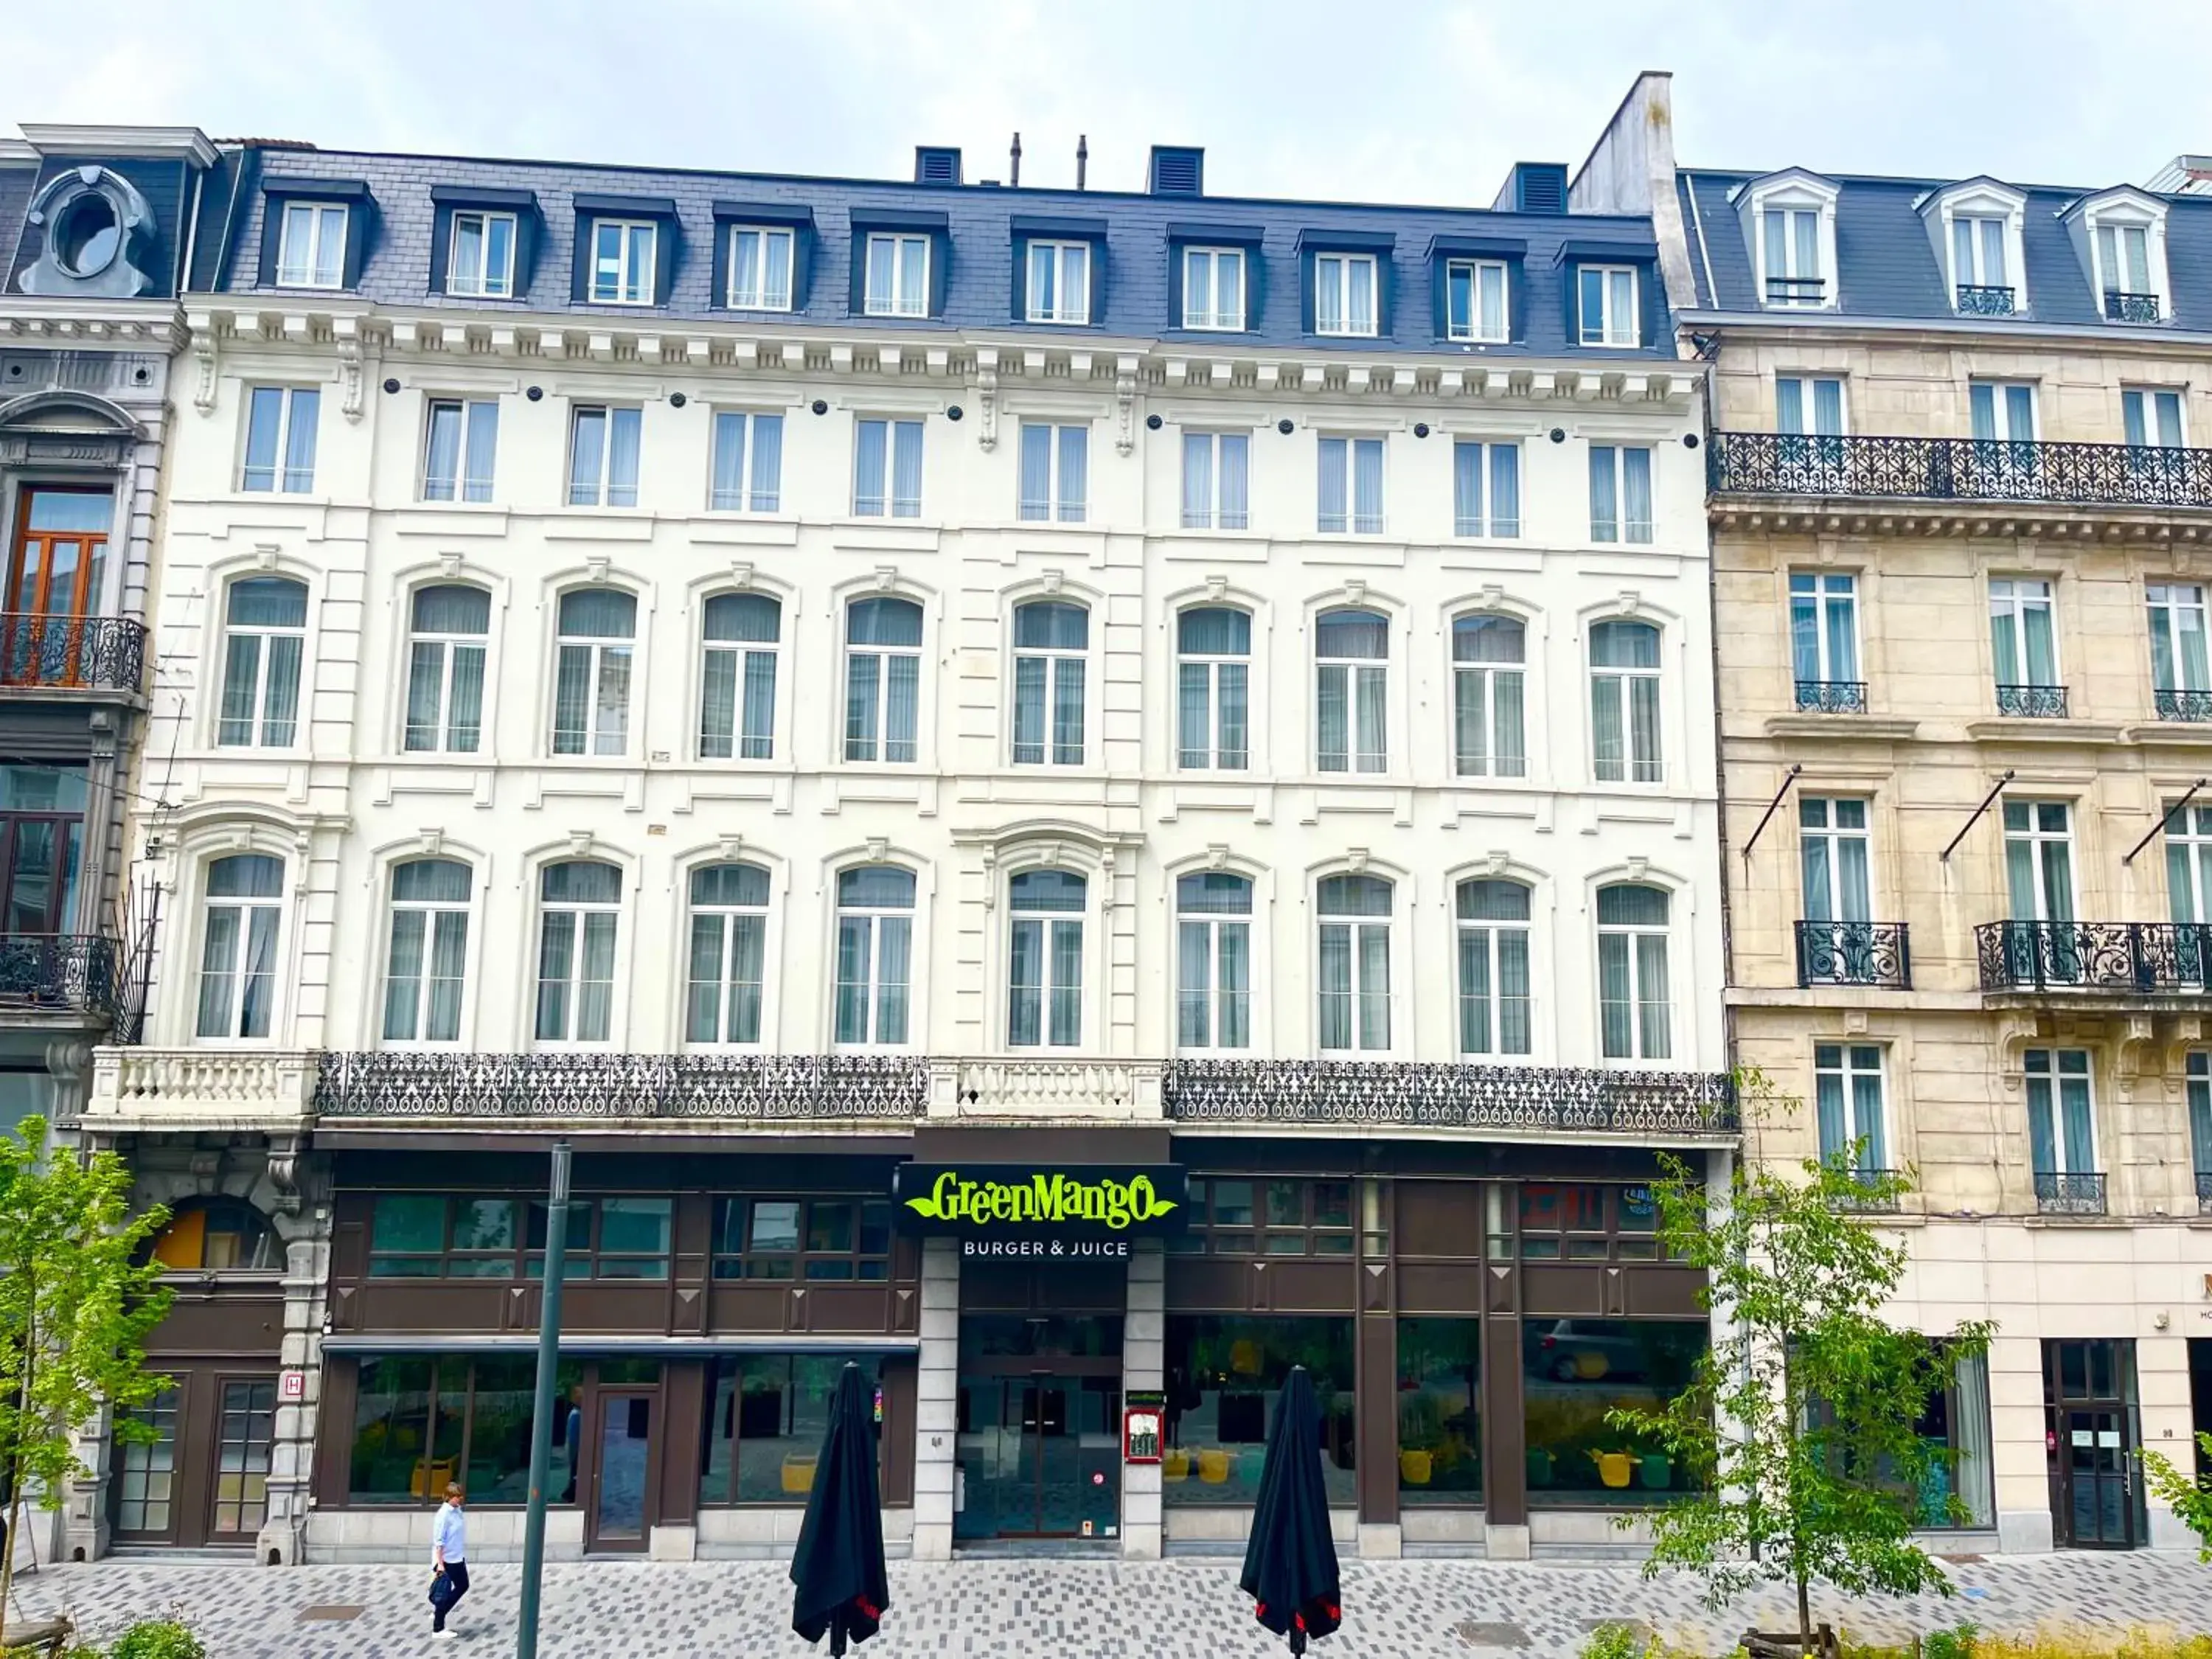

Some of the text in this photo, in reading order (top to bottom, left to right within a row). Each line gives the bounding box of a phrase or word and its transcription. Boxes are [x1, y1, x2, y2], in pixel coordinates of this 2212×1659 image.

[964, 1239, 1128, 1256] BURGER & JUICE
[290, 1378, 299, 1391] H
